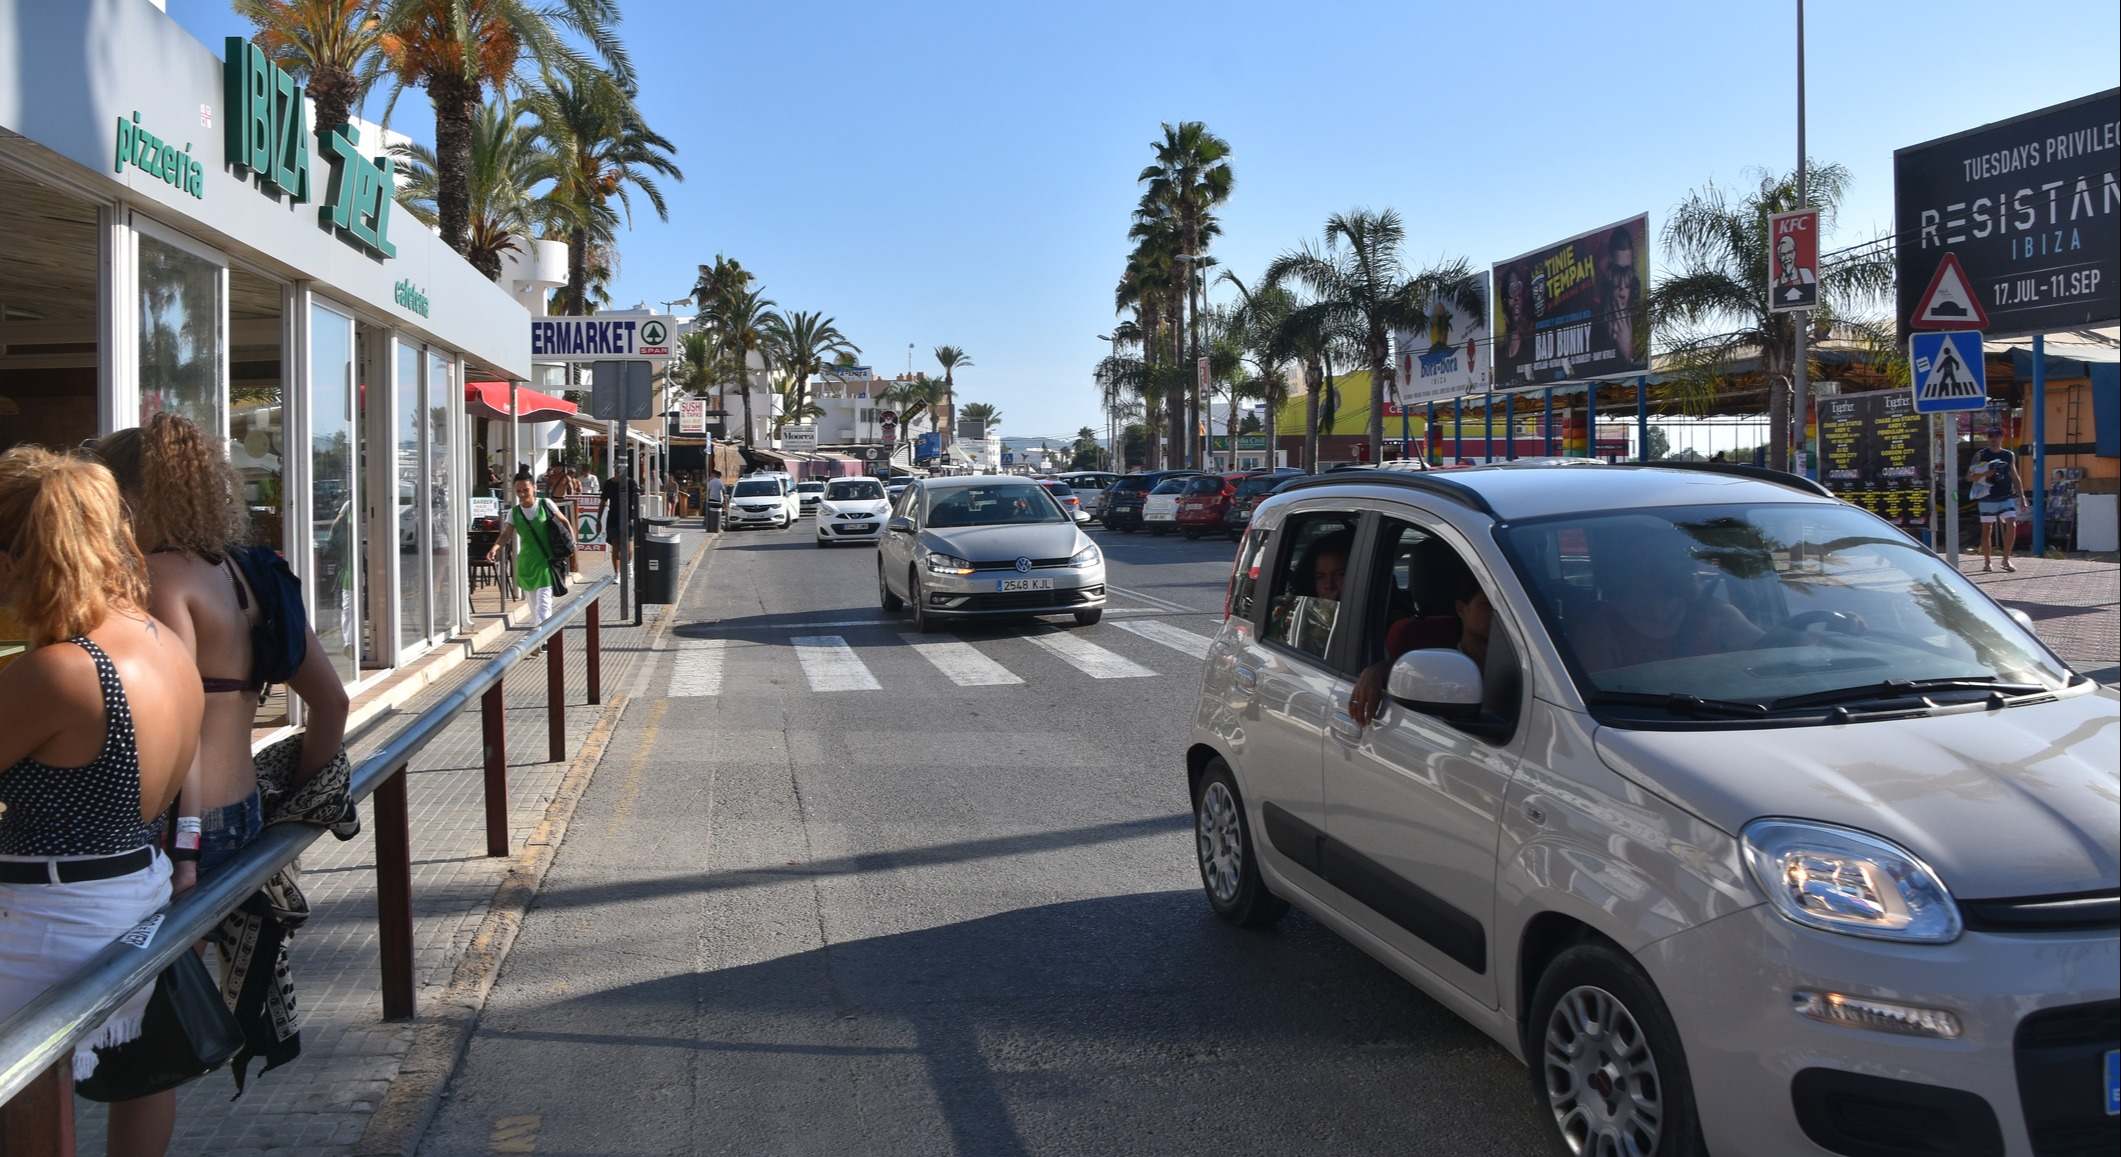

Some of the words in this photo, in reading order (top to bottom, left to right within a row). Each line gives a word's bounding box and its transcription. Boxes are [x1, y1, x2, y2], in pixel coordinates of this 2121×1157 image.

[224, 36, 311, 204] IBIZA
[1963, 142, 2040, 183] TUESDAYS
[1779, 216, 1809, 234] KFC
[1544, 244, 1575, 278] TINIE
[2012, 228, 2081, 261] IBIZA
[1546, 255, 1596, 299] TEMPAH
[532, 321, 636, 355] ERMARKET
[1535, 331, 1554, 361] BAD
[1557, 322, 1592, 357] BUNNY
[682, 402, 703, 412] SUSHI
[1004, 580, 1028, 591] 2548
[1032, 579, 1050, 590] KJL
